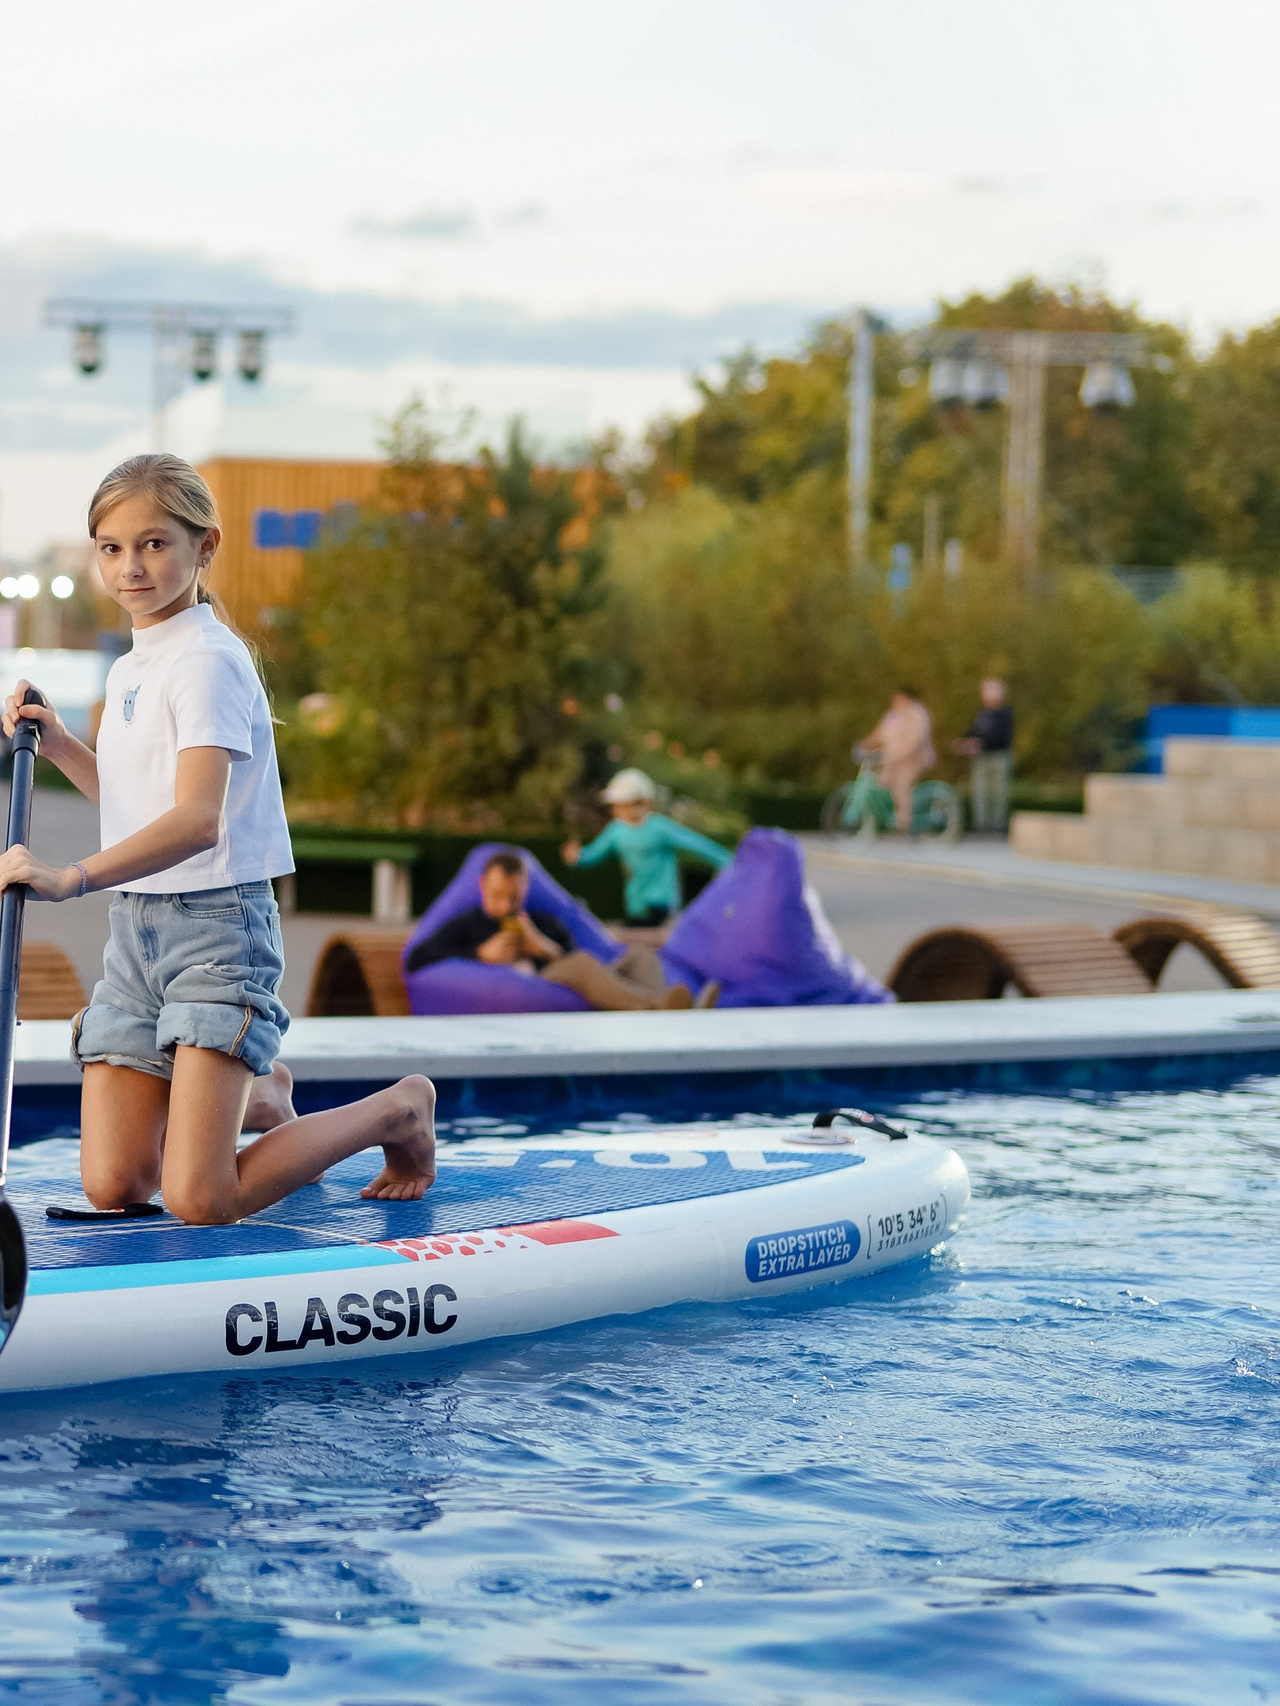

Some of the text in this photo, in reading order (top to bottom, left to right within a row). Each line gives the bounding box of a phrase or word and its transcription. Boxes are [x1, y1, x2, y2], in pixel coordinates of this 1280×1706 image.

[756, 1225, 847, 1260] DROPSTITCH
[757, 1244, 852, 1277] EXTRA LAYER
[225, 1283, 458, 1356] CLASSIC
